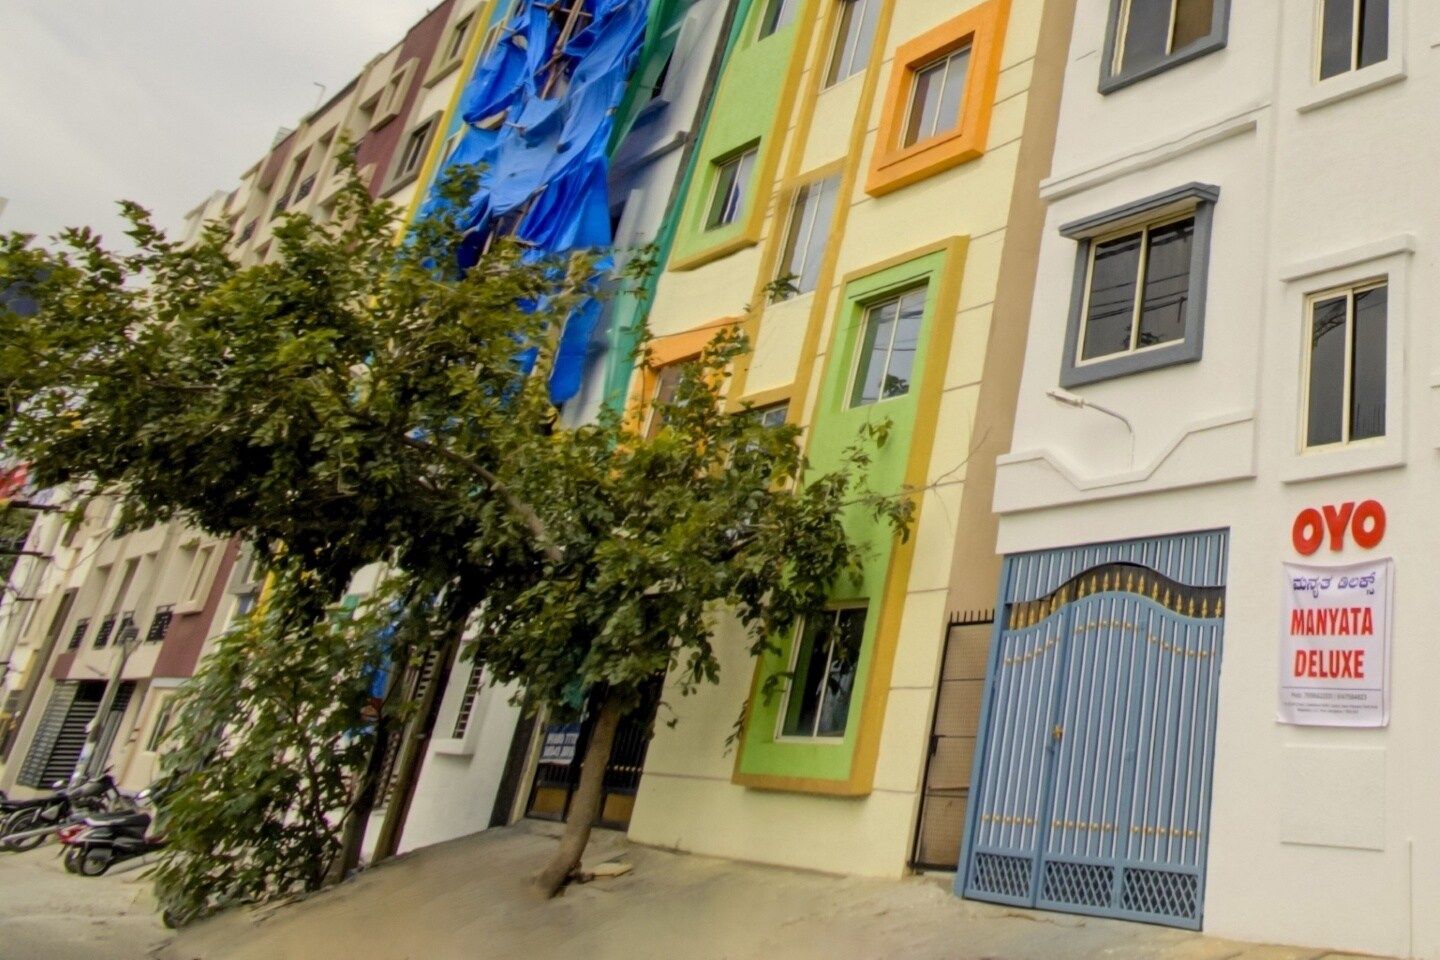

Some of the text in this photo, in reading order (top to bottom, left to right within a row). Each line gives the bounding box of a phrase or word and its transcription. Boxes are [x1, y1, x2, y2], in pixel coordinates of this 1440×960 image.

[1292, 500, 1385, 556] OYO
[1291, 607, 1374, 636] MANYATA
[1294, 649, 1365, 679] DELUXE
